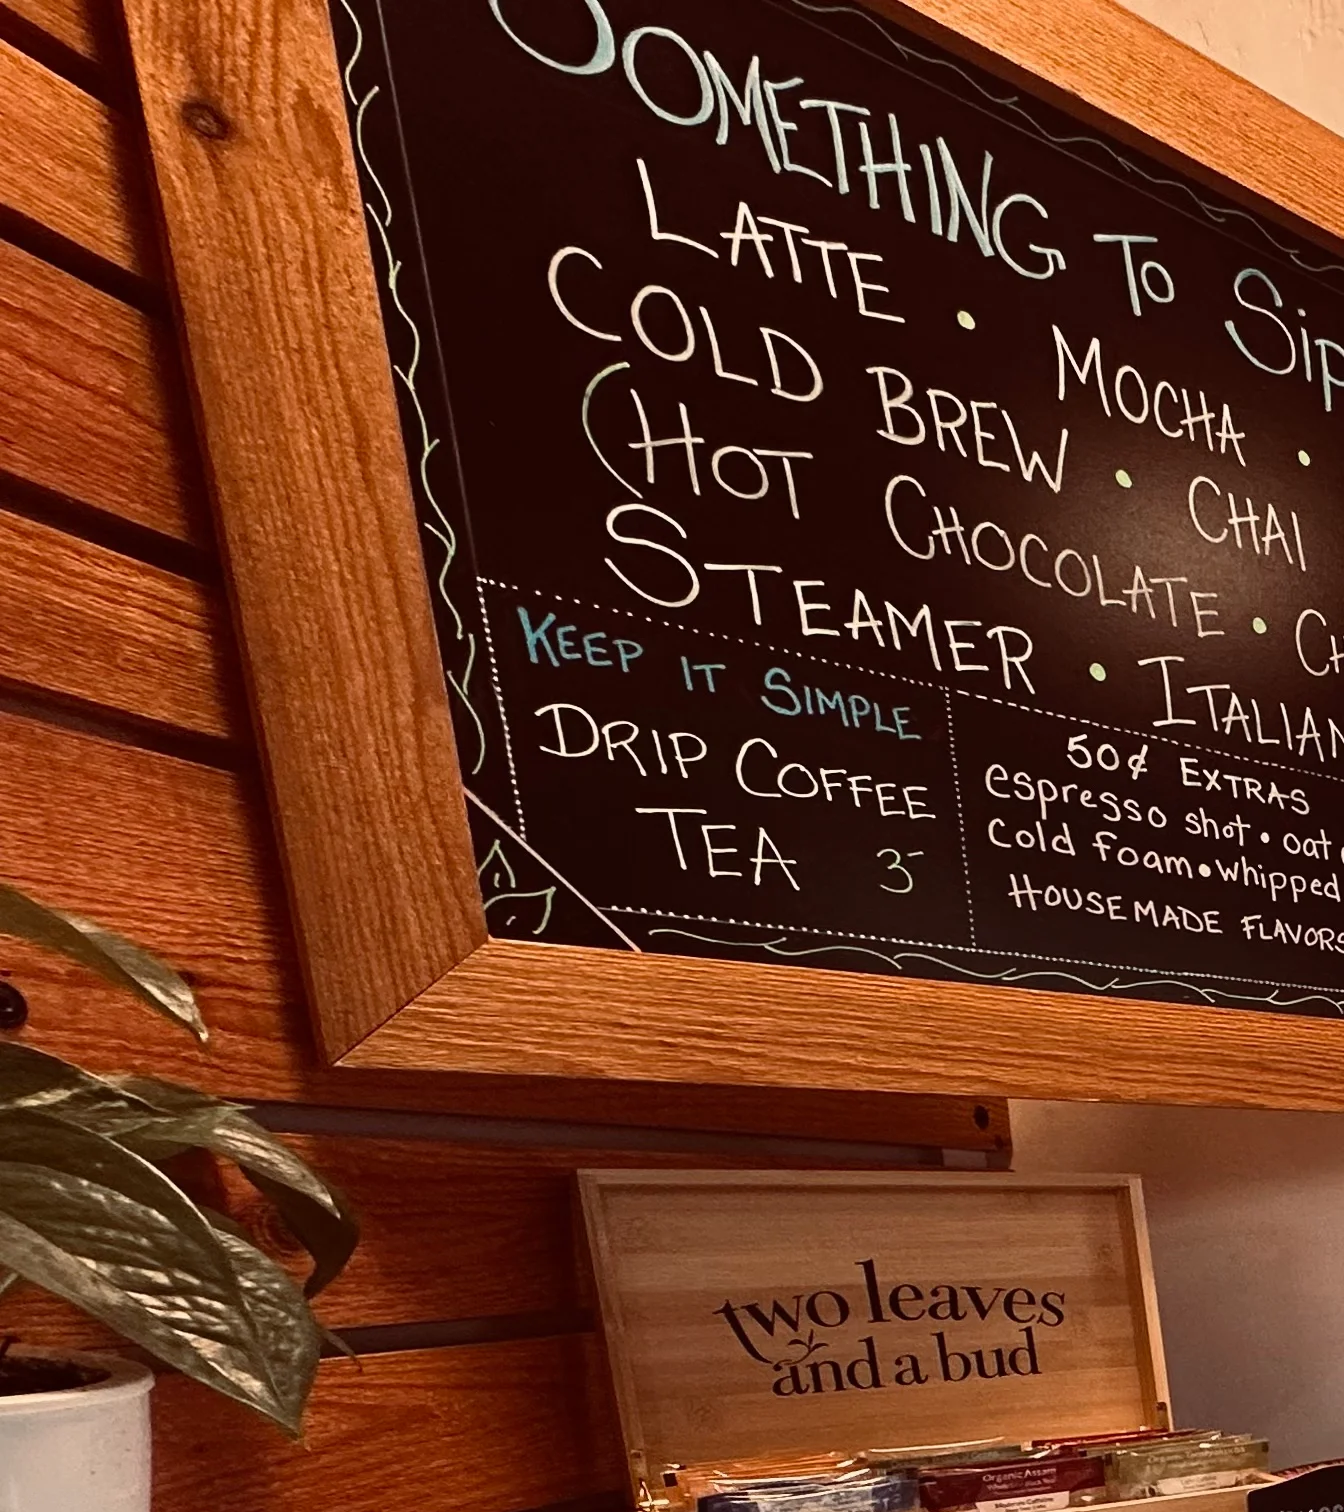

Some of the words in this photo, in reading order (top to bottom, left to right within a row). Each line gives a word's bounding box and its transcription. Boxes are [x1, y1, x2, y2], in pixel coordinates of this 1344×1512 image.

[636, 157, 906, 325] LATTE
[1052, 325, 1246, 467] MOCHA
[548, 246, 824, 403] COLD
[866, 366, 1069, 494] BREW
[1188, 476, 1307, 572] CHAI
[604, 503, 1035, 695] STEAMER
[884, 475, 1225, 637] CHOCOLATE
[517, 606, 644, 673] KEEP
[680, 656, 726, 693] IT
[761, 667, 922, 741] SIMPLE
[534, 703, 708, 779] DRIP
[735, 737, 937, 820] COFFEE
[985, 764, 1168, 830] espresso
[1185, 807, 1252, 846] shot
[1283, 829, 1333, 861] oat
[1179, 757, 1311, 816] EXTRAS
[635, 807, 800, 891] TEA
[712, 1289, 850, 1365] two
[855, 1258, 1066, 1328] leaves
[771, 1336, 887, 1397] and
[894, 1354, 929, 1387] a
[931, 1326, 1043, 1383] bud
